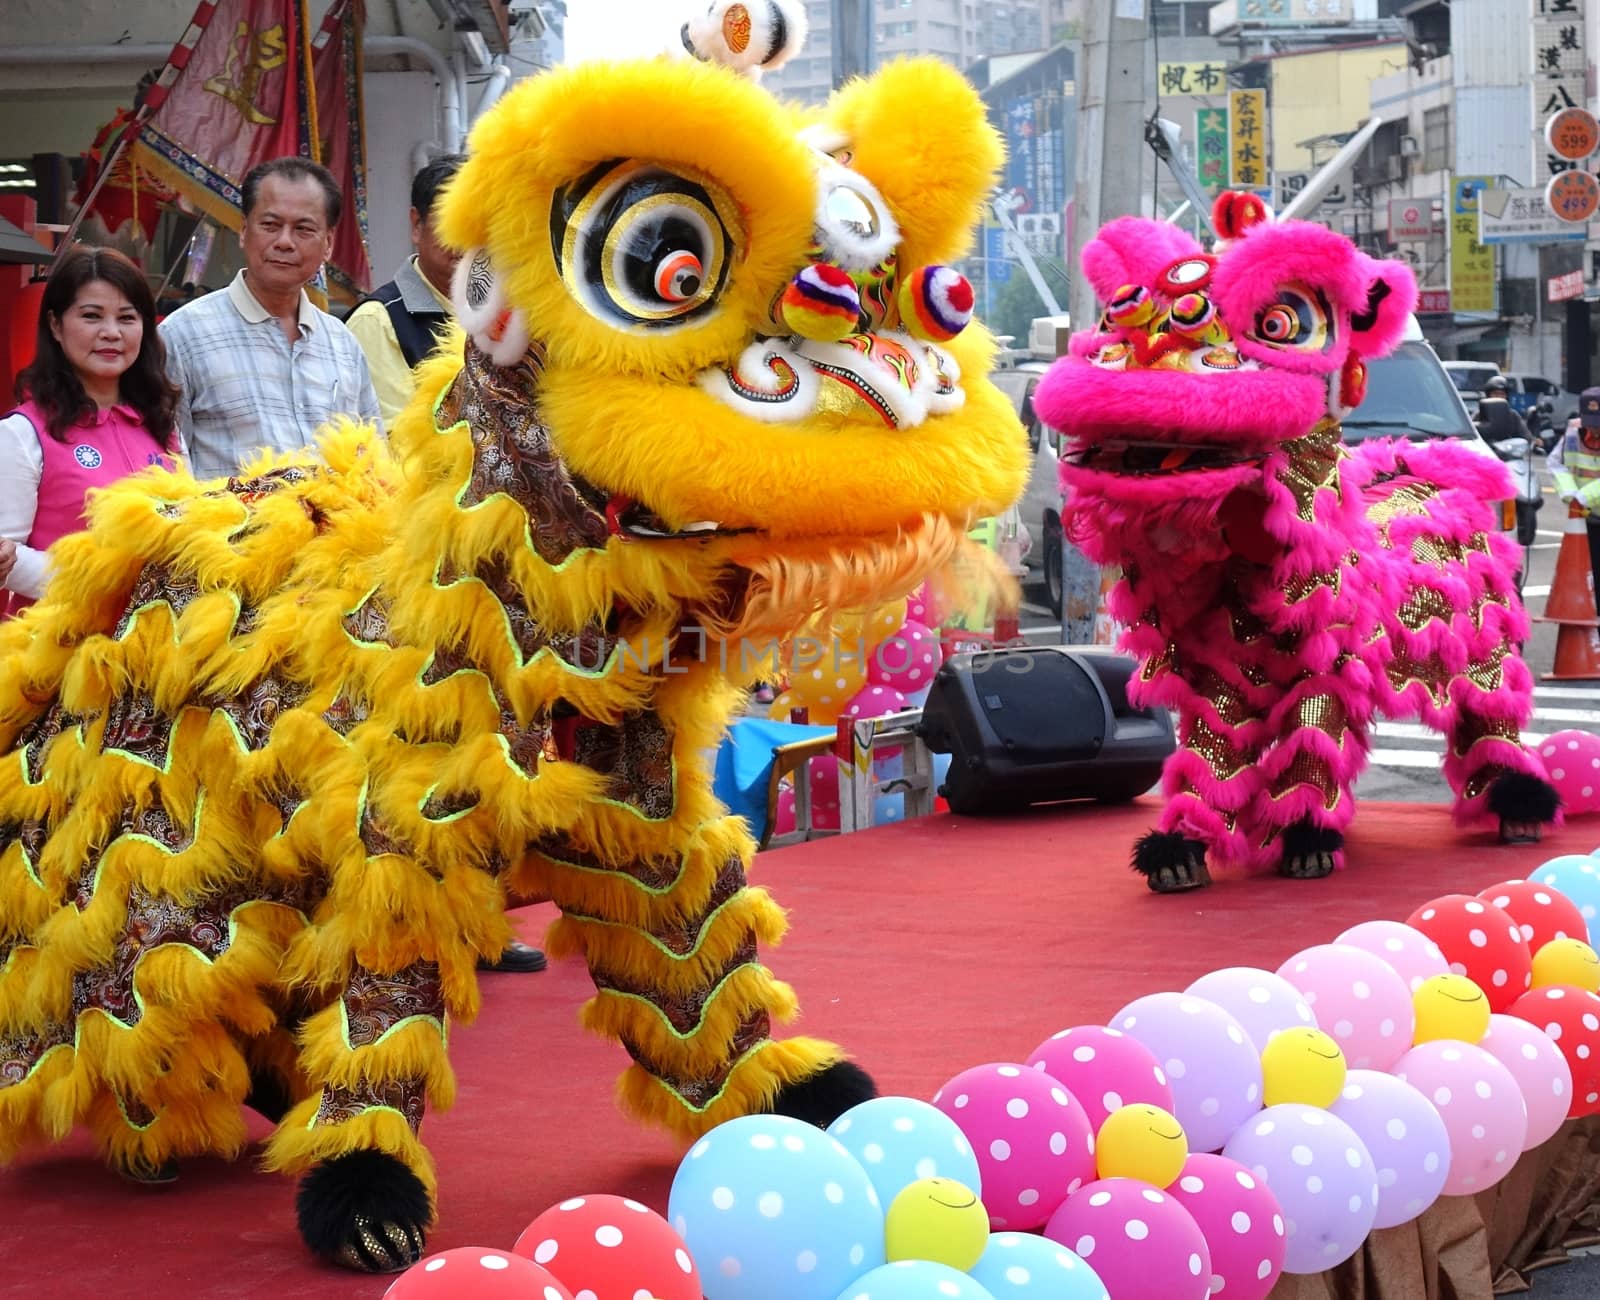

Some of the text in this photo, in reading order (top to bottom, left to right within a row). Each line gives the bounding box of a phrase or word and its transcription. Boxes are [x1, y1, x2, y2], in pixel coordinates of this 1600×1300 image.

[1162, 64, 1220, 93] 帆布
[1560, 134, 1588, 148] 599
[1562, 198, 1588, 212] 499
